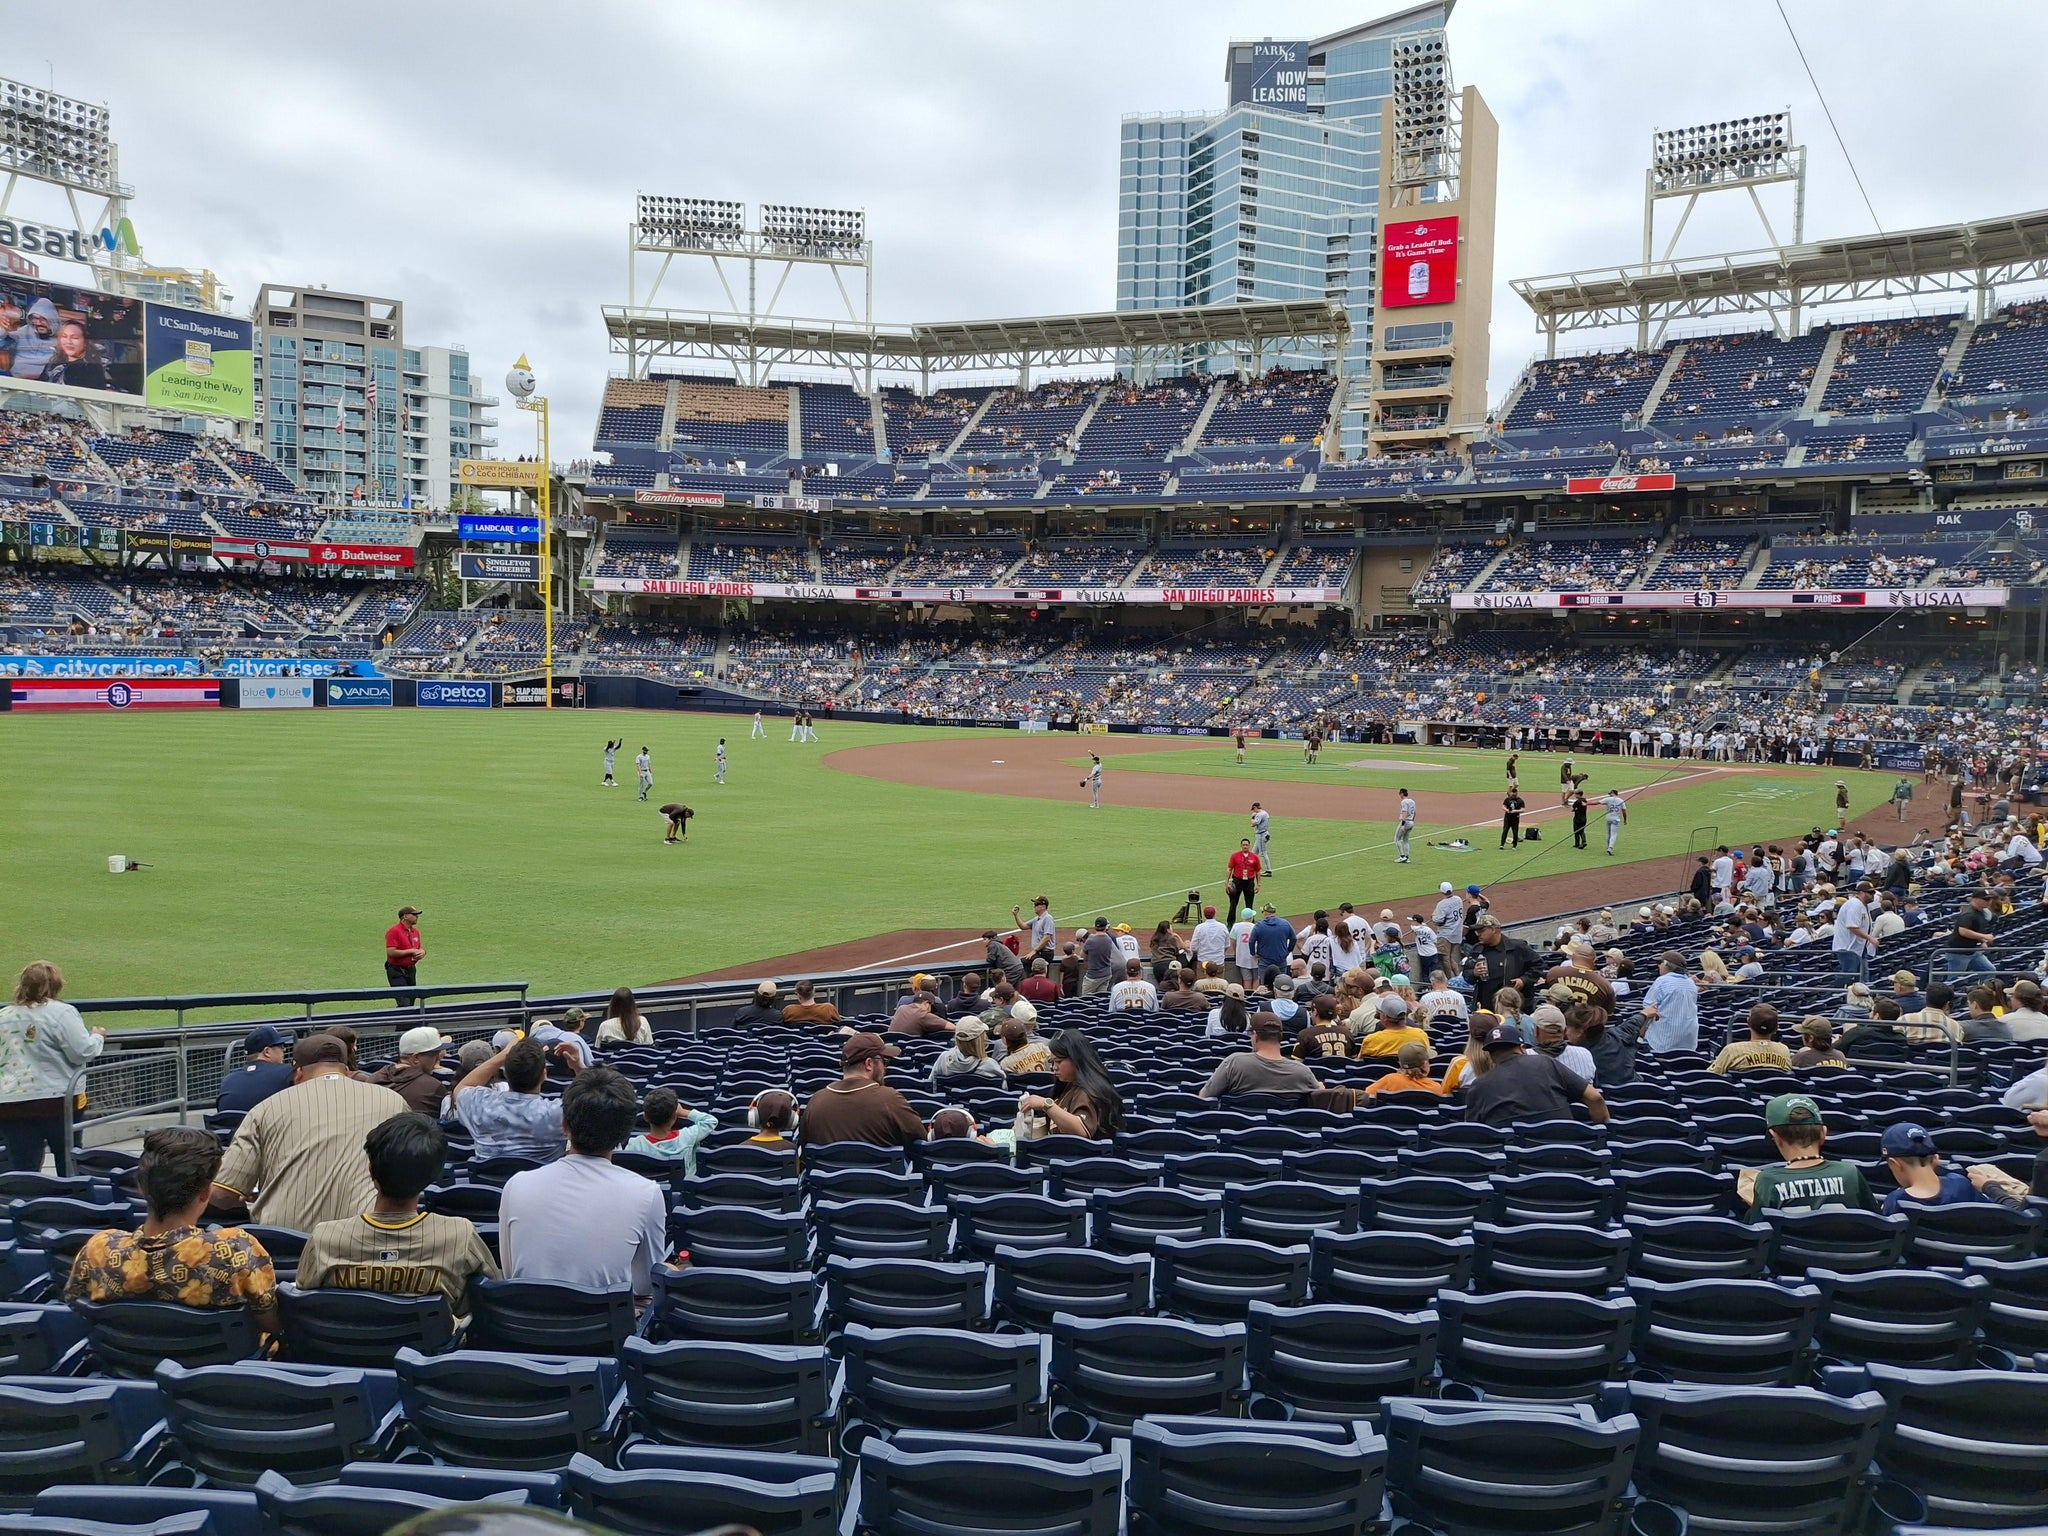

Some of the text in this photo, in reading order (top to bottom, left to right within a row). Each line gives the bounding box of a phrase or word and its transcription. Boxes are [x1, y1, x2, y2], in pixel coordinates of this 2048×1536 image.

[1254, 45, 1287, 56] PARK
[1283, 52, 1296, 62] 12
[1276, 71, 1306, 86] NOW
[1252, 87, 1306, 102] LEASING
[1407, 249, 1427, 257] Game
[159, 316, 239, 340] UC San Diego Health
[187, 341, 210, 353] BEST
[161, 373, 244, 396] Leading the Way
[161, 387, 218, 404] in San Diego
[1948, 443, 2028, 456] STEVE 6 GARVEY
[476, 470, 497, 478] CoCo
[637, 490, 724, 505] Tarantino SAUSAGES
[795, 498, 819, 509] 12:50
[1936, 514, 1962, 525] RAK
[475, 523, 515, 533] LANDCARE
[139, 538, 169, 546] @PADRES
[181, 541, 212, 549] @PADRES
[341, 550, 402, 562] Budweiser
[485, 557, 531, 566] SINGLETON
[485, 564, 531, 573] SCHREIBER
[643, 580, 754, 596] SAN DIEGO PADRES
[802, 587, 836, 599] USAA
[1093, 591, 1126, 602] USAA
[1162, 588, 1275, 602] SAN DIEGO PADRES
[1576, 596, 1609, 605] SAN DIEGO
[1813, 594, 1842, 603] PADRES
[1914, 592, 1966, 606] USAA
[1494, 596, 1533, 608] USAA
[54, 659, 178, 676] citycruises
[242, 687, 265, 697] blue
[278, 687, 301, 697] blue
[343, 687, 391, 697] VANDA
[441, 684, 487, 700] petco
[516, 687, 531, 696] SLAP
[516, 695, 534, 703] CHEESE
[1150, 725, 1172, 734] petco
[1186, 726, 1208, 735] petco
[1896, 759, 1921, 769] petco
[1352, 928, 1367, 942] 23
[1123, 941, 1136, 952] 20
[1417, 936, 1428, 946] 12
[1557, 976, 1599, 996] MACHADO
[1120, 989, 1138, 997] TATIS
[1321, 1042, 1346, 1057] 23
[1013, 1050, 1047, 1073] MACHADO
[1745, 1053, 1788, 1068] MACHADO
[1775, 1176, 1845, 1201] MATTAINI
